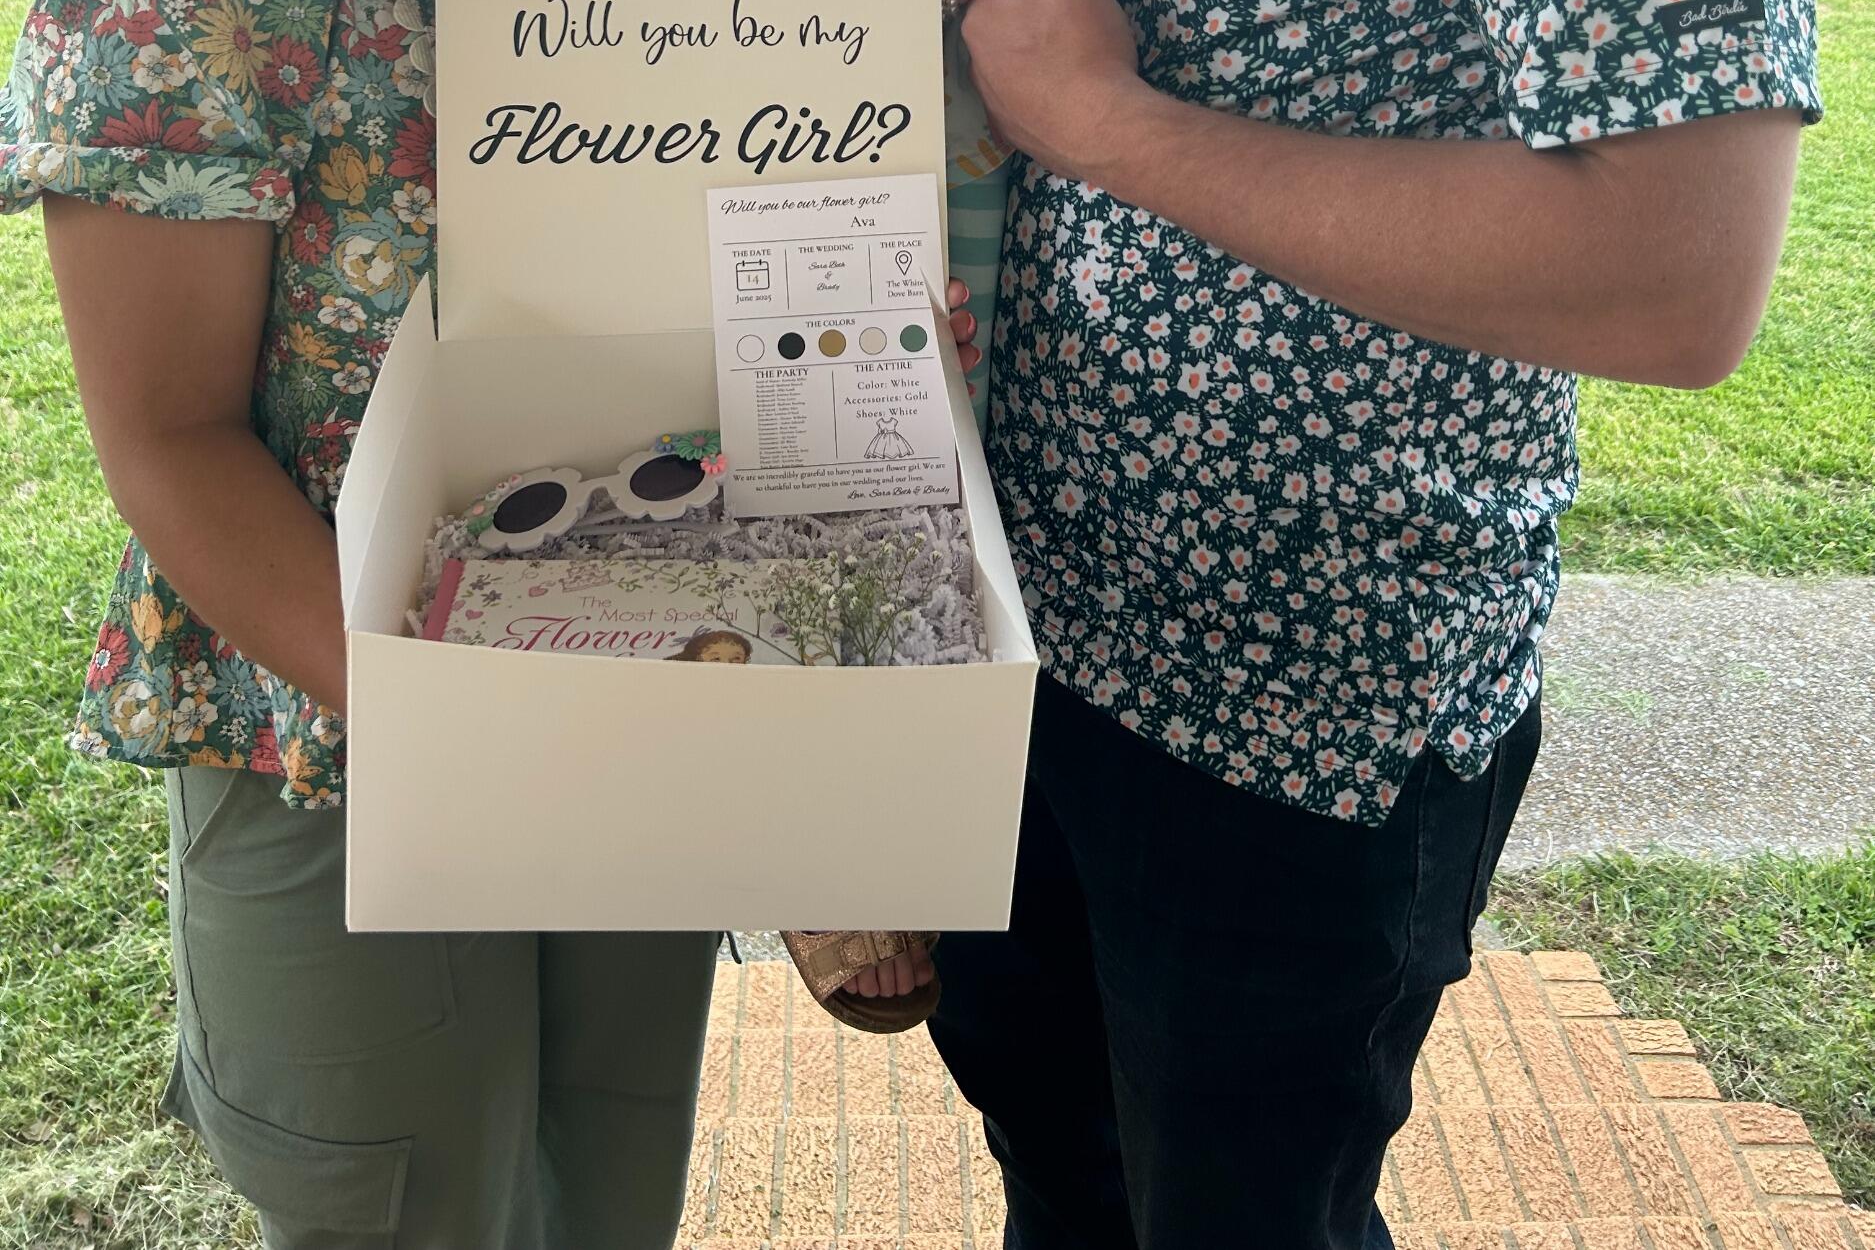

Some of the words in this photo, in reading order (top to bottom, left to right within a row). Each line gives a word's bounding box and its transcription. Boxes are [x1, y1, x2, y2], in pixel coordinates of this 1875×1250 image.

[1679, 4, 1707, 27] Bad
[640, 20, 719, 65] you
[799, 14, 870, 65] my
[469, 101, 720, 165] Flower
[737, 100, 912, 175] Girl?
[721, 199, 756, 214] Will
[758, 202, 780, 215] you
[782, 199, 795, 210] be
[796, 201, 818, 209] our
[818, 196, 855, 213] flower
[858, 193, 890, 208] girl?
[850, 216, 876, 228] Ava
[798, 245, 816, 254] THE
[816, 244, 854, 252] WEDDING
[880, 241, 897, 249] THE
[897, 240, 922, 248] PLACE
[732, 250, 749, 258] THE
[749, 248, 772, 257] DATE
[887, 279, 901, 288] The
[902, 278, 925, 287] White
[736, 294, 754, 305] June
[887, 290, 906, 298] Dove
[805, 319, 823, 328] THE
[823, 318, 857, 327] COLORS
[854, 363, 875, 373] THE
[876, 360, 914, 371] ATTIRE
[755, 369, 775, 379] THE
[776, 367, 810, 378] PARTY
[857, 380, 888, 390] Color:
[890, 378, 921, 388] White
[844, 395, 902, 406] Accessories:
[904, 391, 929, 402] Gold
[888, 406, 919, 417] White
[882, 476, 895, 484] and
[579, 596, 613, 608] The
[599, 608, 657, 622] Most
[491, 615, 678, 651] Flower
